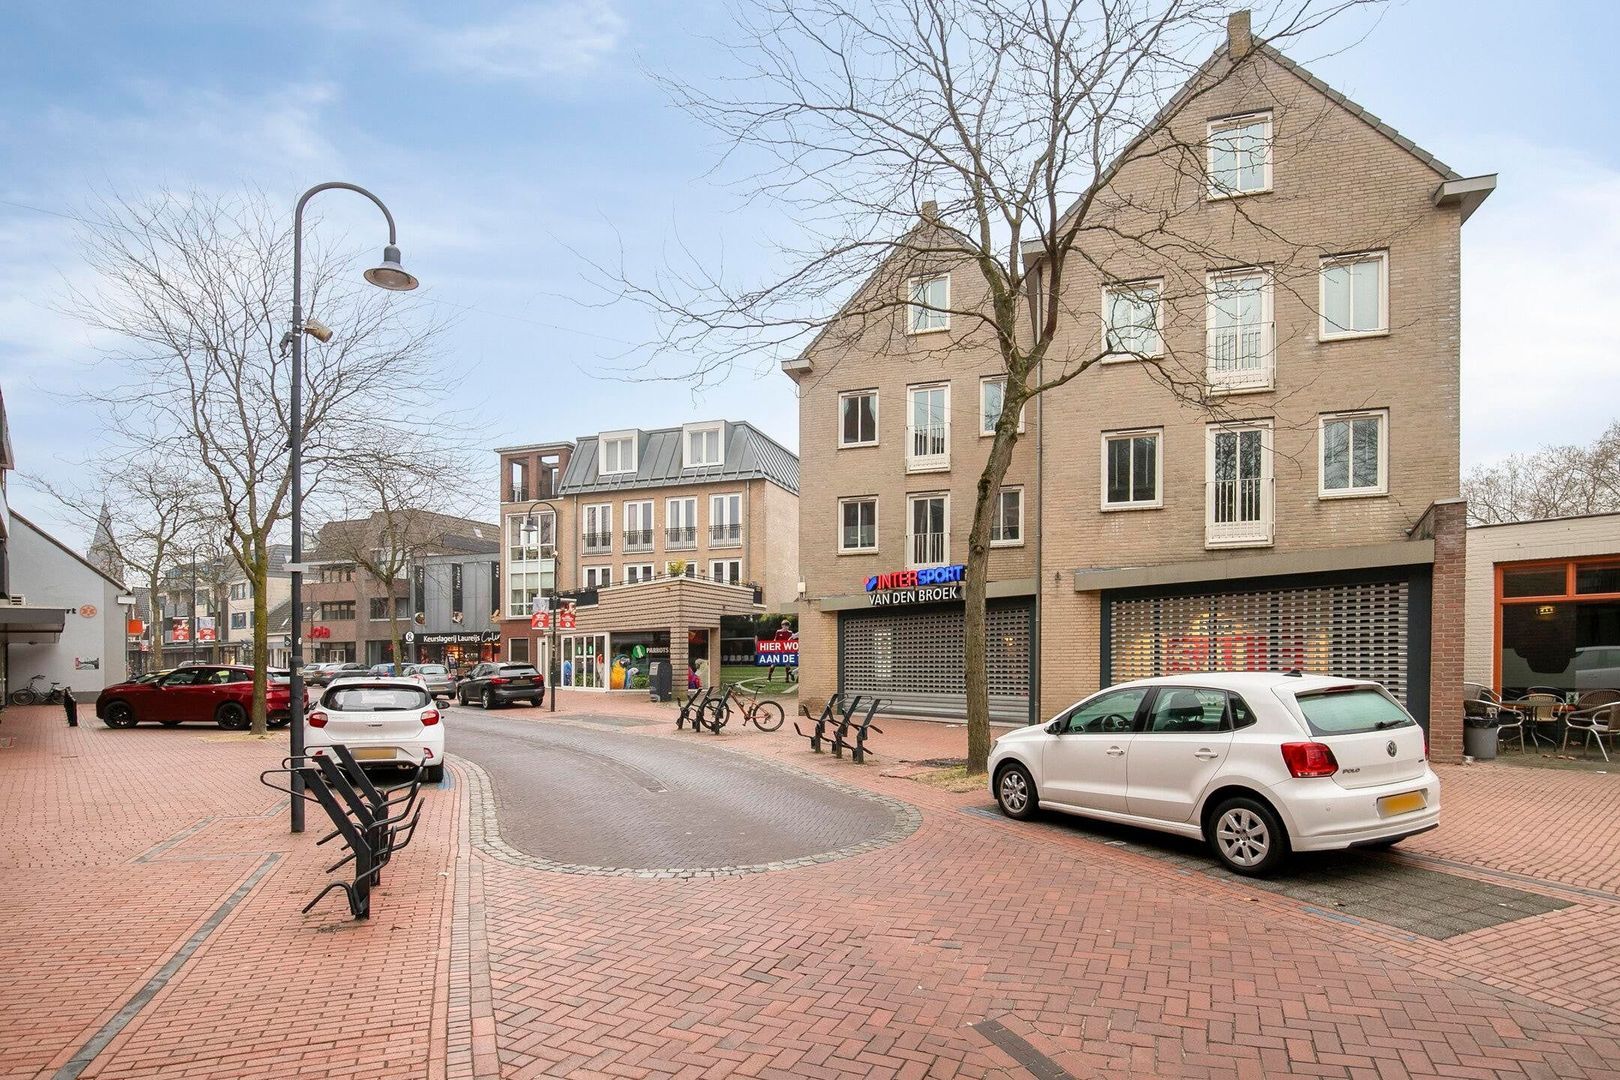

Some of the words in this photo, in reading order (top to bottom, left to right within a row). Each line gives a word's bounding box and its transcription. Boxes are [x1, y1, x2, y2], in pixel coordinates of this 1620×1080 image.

[878, 564, 965, 590] INTERSPORT
[868, 593, 890, 605] VAN
[893, 591, 915, 604] DEN
[918, 586, 958, 602] BROEK
[423, 634, 457, 643] Keurslagerij
[457, 634, 480, 643] Laureijs
[760, 642, 781, 651] HIER
[759, 654, 780, 663] AAN
[782, 654, 795, 663] DE
